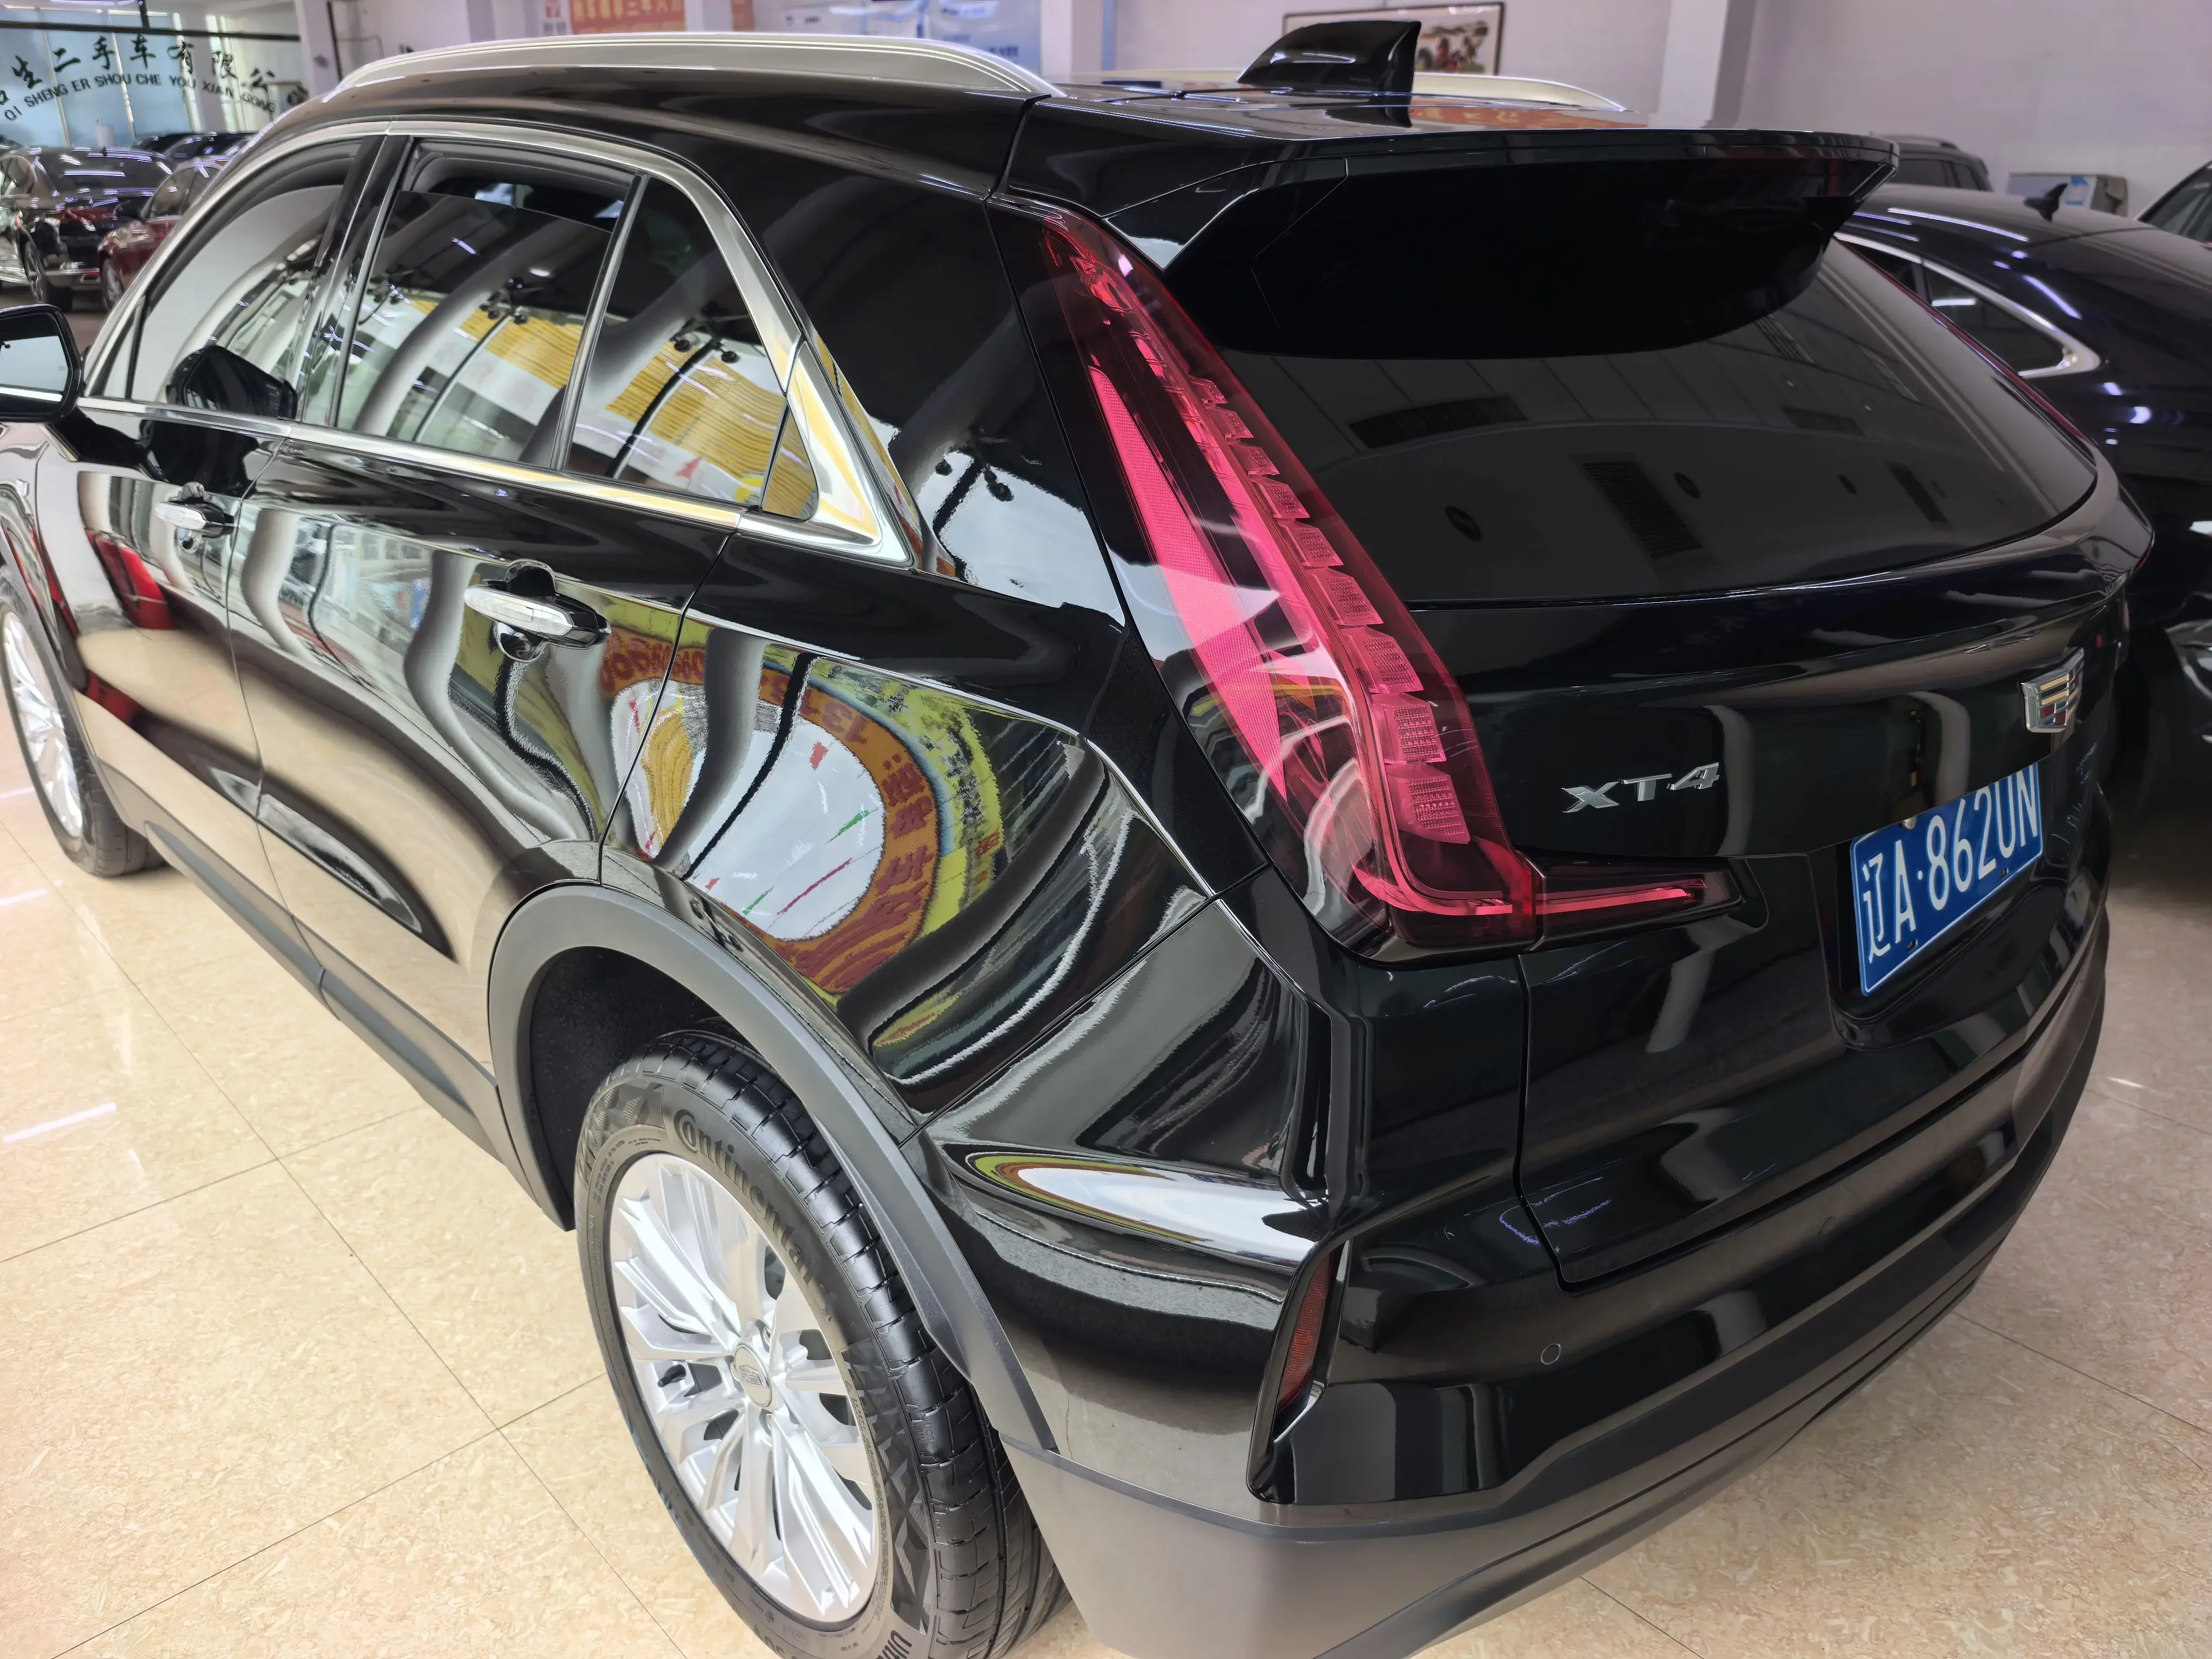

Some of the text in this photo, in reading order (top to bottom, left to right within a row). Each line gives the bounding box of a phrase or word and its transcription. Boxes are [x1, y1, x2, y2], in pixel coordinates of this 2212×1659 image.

[24, 83, 69, 107] SHENG
[71, 78, 91, 91] ER
[94, 73, 131, 87] SHOU
[136, 73, 163, 86] CHE
[170, 75, 196, 91] YOU
[1561, 762, 1719, 813] XT4
[673, 1109, 814, 1286] Continental
